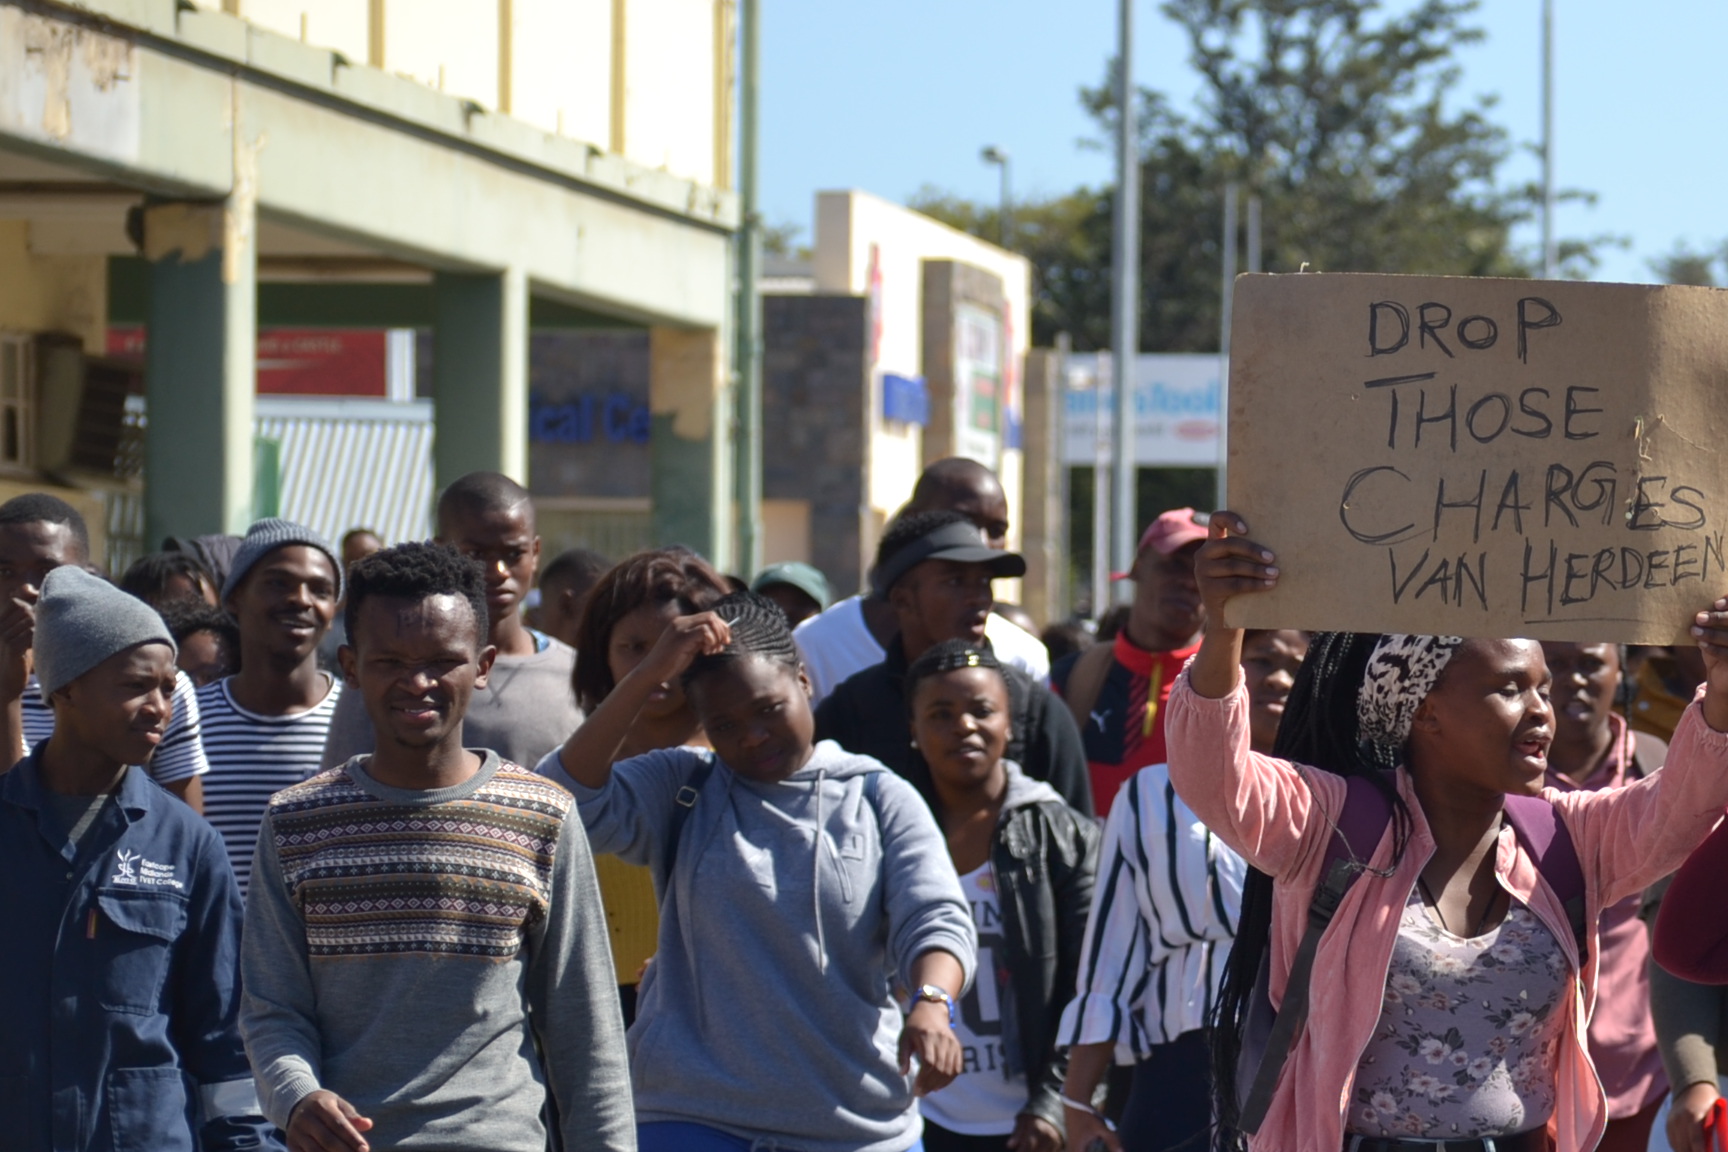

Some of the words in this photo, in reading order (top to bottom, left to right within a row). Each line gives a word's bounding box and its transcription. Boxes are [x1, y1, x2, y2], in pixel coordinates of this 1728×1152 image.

[1364, 296, 1563, 364] DROP
[1364, 371, 1603, 453] THOSE
[1340, 463, 1706, 544] CHARGES
[1388, 546, 1489, 612] VAN
